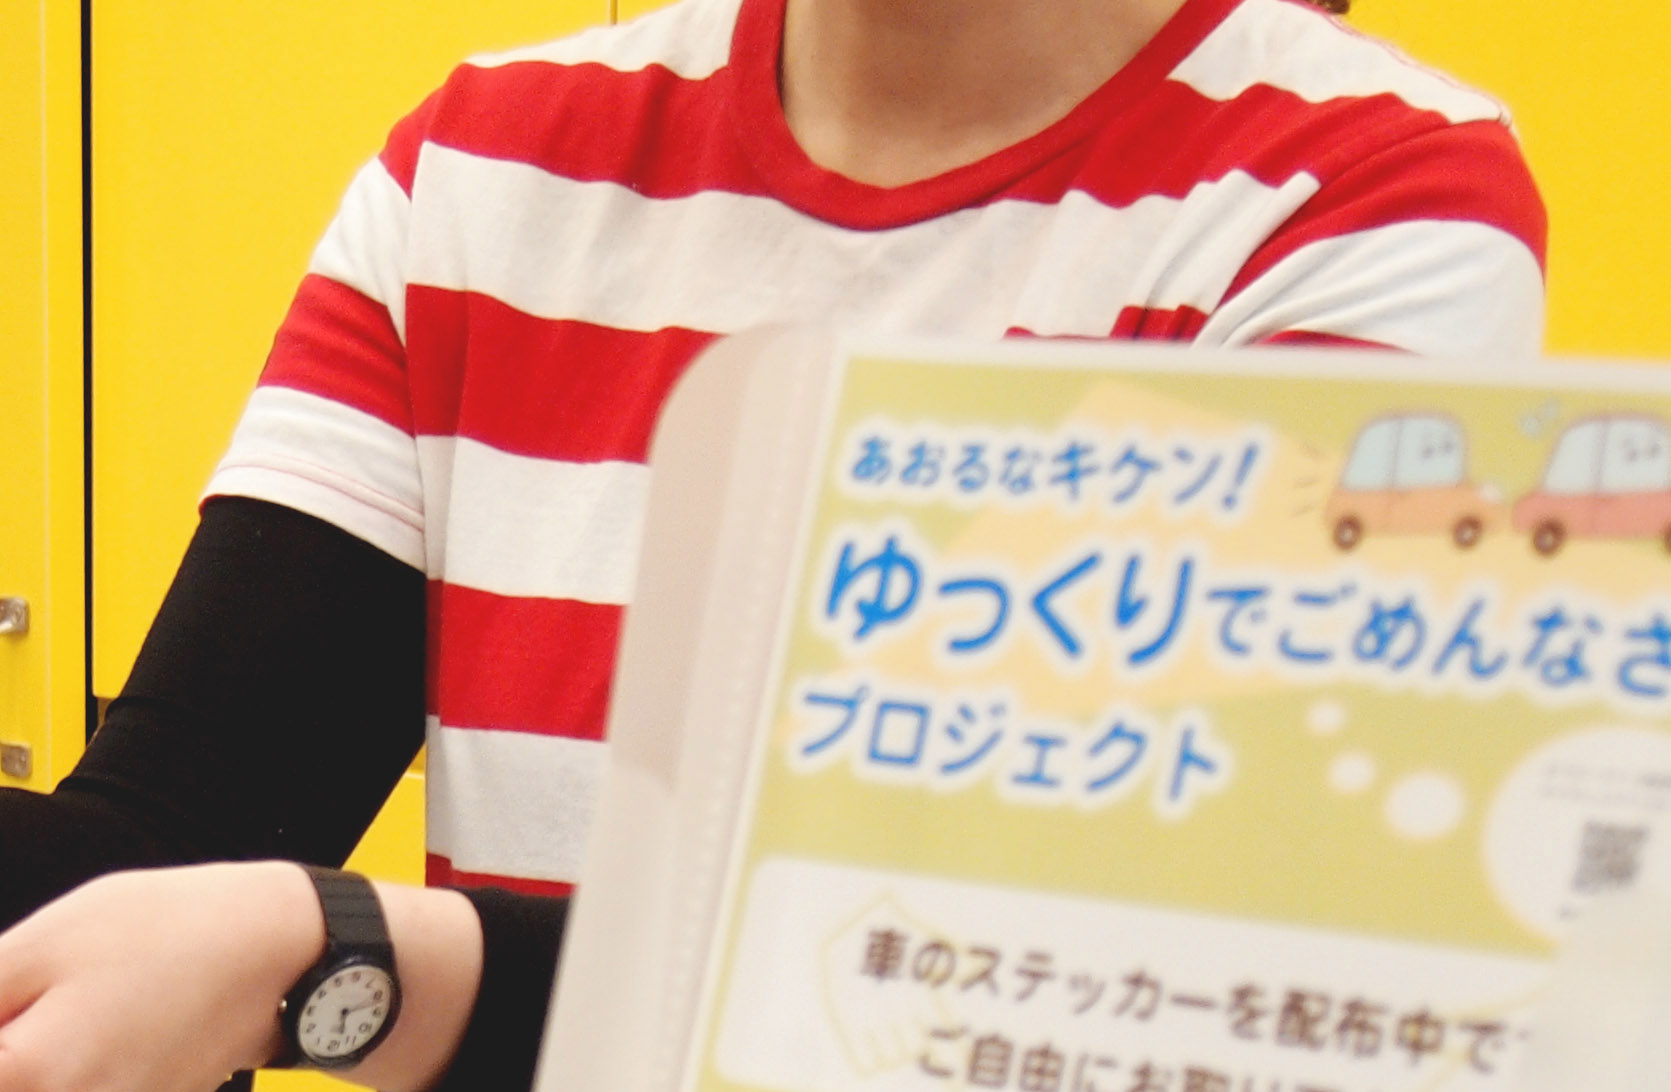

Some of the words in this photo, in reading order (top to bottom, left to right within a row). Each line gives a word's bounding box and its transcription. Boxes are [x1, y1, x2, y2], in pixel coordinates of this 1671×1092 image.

[799, 686, 1220, 801] プロジェクト
[858, 926, 1533, 1076] 車のステッカーを配布中で
